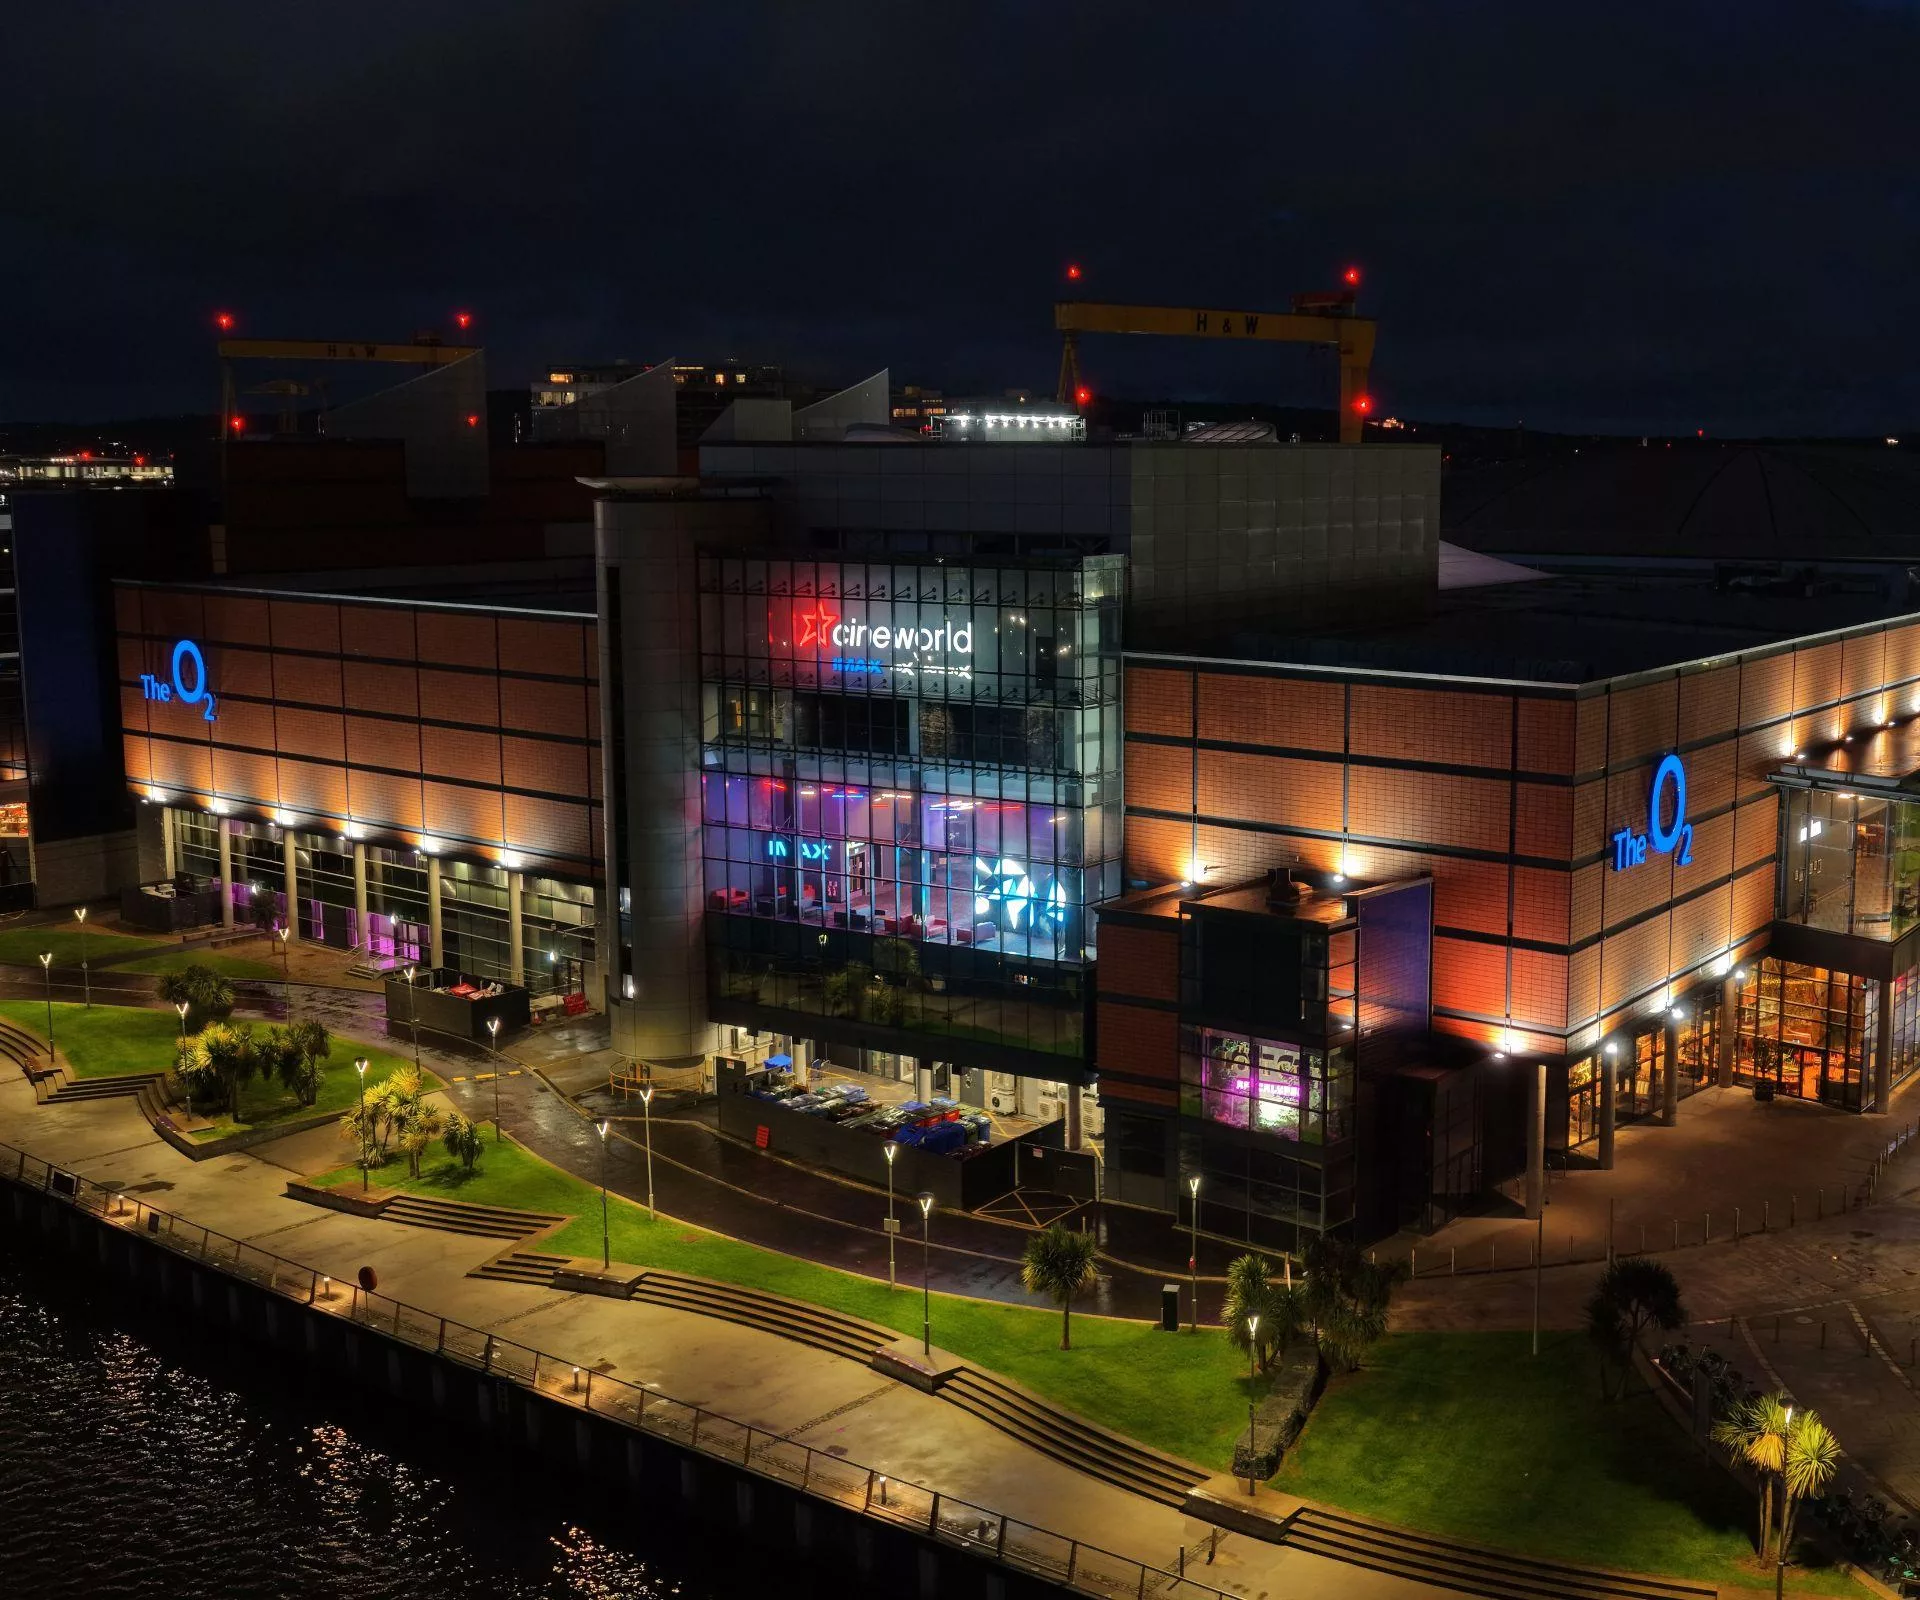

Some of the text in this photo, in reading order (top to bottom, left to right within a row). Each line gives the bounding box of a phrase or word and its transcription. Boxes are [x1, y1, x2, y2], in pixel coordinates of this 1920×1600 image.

[1197, 311, 1258, 335] H & W
[328, 344, 336, 357] H
[365, 345, 376, 357] W
[832, 618, 972, 653] cineworld
[832, 656, 883, 674] IMAX
[140, 674, 171, 702] The
[1612, 827, 1647, 871] The
